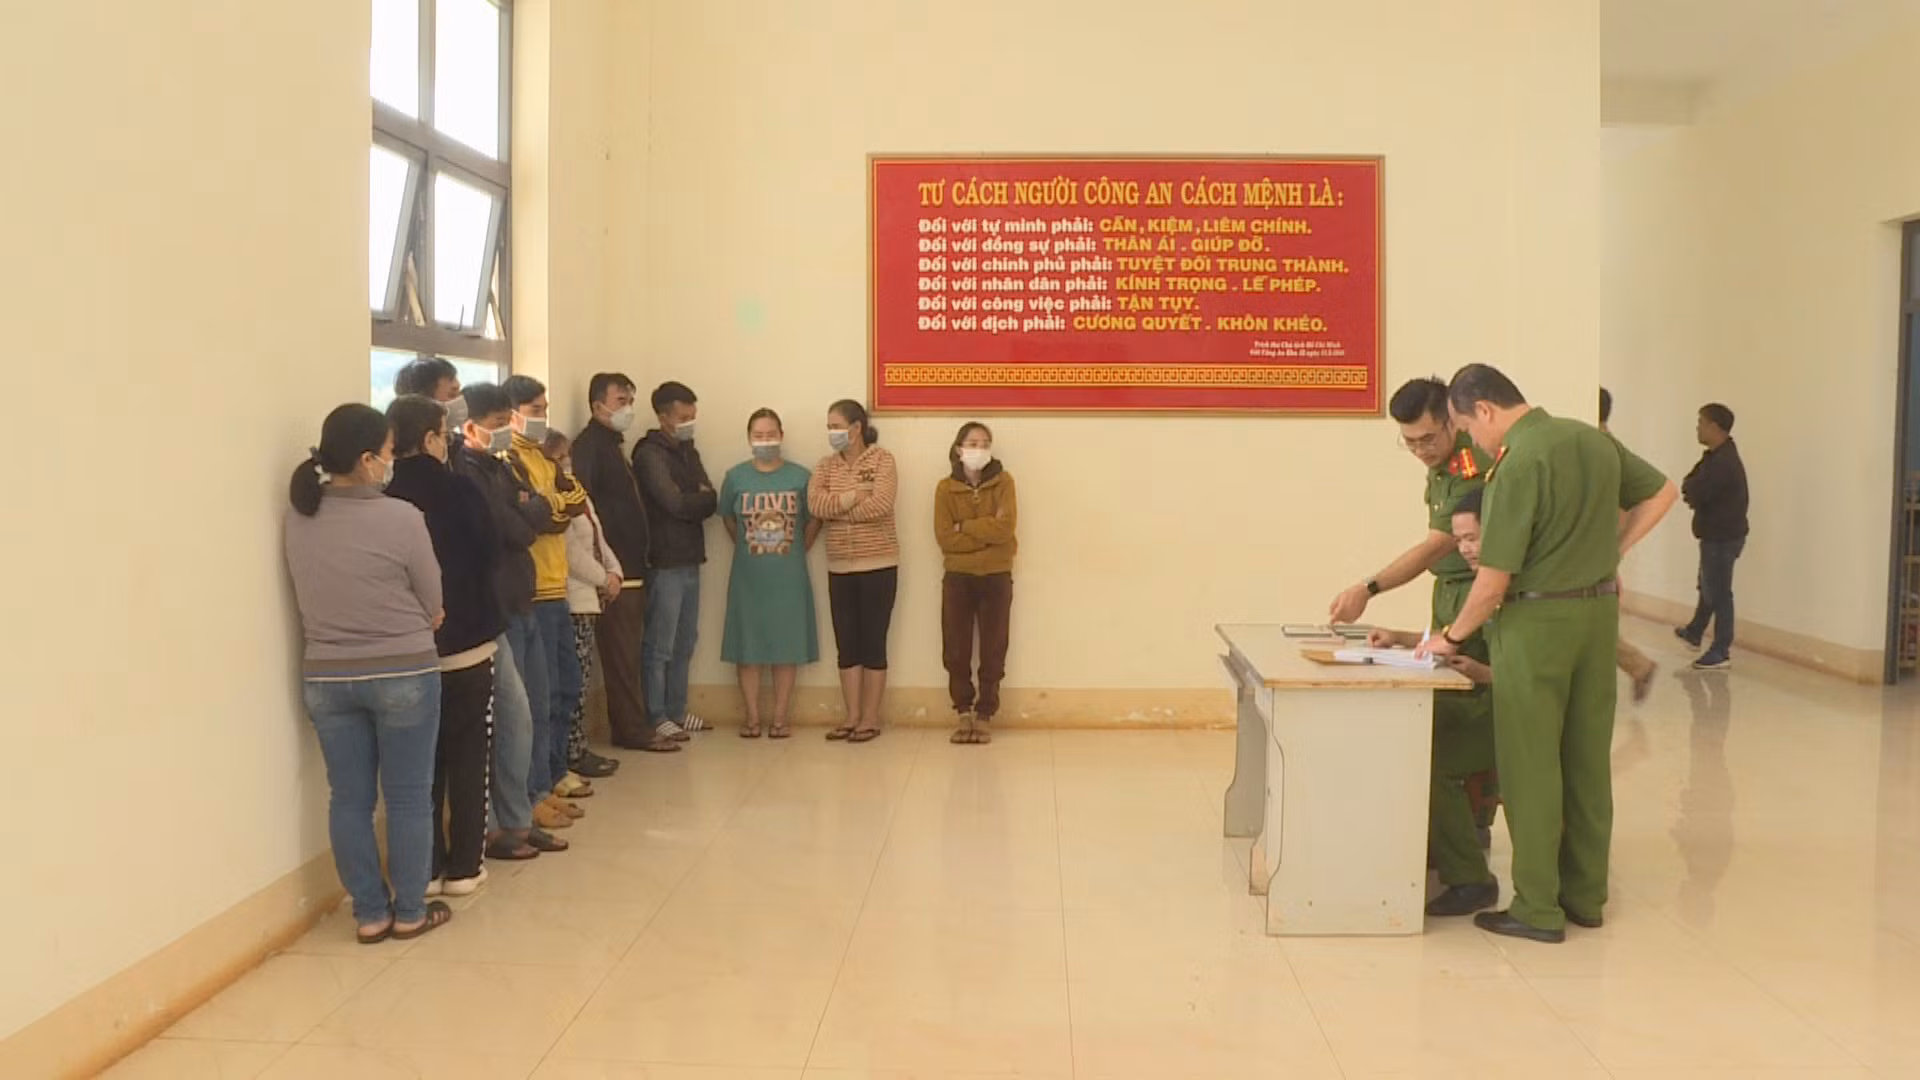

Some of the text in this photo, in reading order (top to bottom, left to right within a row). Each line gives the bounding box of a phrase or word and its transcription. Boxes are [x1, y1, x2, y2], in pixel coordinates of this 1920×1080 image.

[918, 180, 946, 206] TƯ
[951, 176, 1009, 206] CÁCH
[1014, 176, 1079, 206] NGƯỜI
[1083, 176, 1140, 206] CÔNG
[1144, 180, 1173, 206] AN
[1180, 176, 1237, 206] CÁCH
[1242, 178, 1303, 211] MỆNH
[918, 216, 947, 233] Đối
[951, 216, 977, 233] với
[981, 218, 1001, 236] tự
[1051, 216, 1094, 235] phải:
[1203, 216, 1246, 234] LIÊM
[1249, 216, 1312, 236] CHÍNH.
[918, 236, 947, 253] Đối
[951, 236, 977, 253] với
[1028, 238, 1050, 256] sự
[1053, 236, 1097, 255] phải:
[1190, 234, 1234, 253] GIÚP
[918, 256, 947, 273] Đối
[951, 256, 977, 273] với
[981, 256, 1030, 273] chính
[1033, 256, 1067, 274] phủ
[1070, 256, 1113, 274] phải:
[1116, 256, 1176, 275] TUYỆT
[1216, 258, 1278, 274] TRUNG
[1282, 256, 1350, 275] THÀNH.
[918, 276, 947, 293] Đối
[951, 276, 977, 293] với
[981, 276, 1025, 293] nhân
[1028, 276, 1061, 293] dân
[1064, 274, 1108, 294] phải:
[1116, 276, 1161, 292] KÍNH
[1269, 276, 1323, 293] PHÉP.
[918, 294, 1201, 316] Đối với công việc phải: TẬN TỤY.
[918, 314, 947, 333] Đối
[951, 314, 977, 333] với
[981, 316, 1020, 336] địch
[1022, 314, 1066, 333] phải:
[1072, 314, 1138, 332] CƯƠNG
[1217, 314, 1269, 333] KHÔN
[1272, 314, 1330, 334] KHÉO.
[742, 492, 798, 514] LOVE
